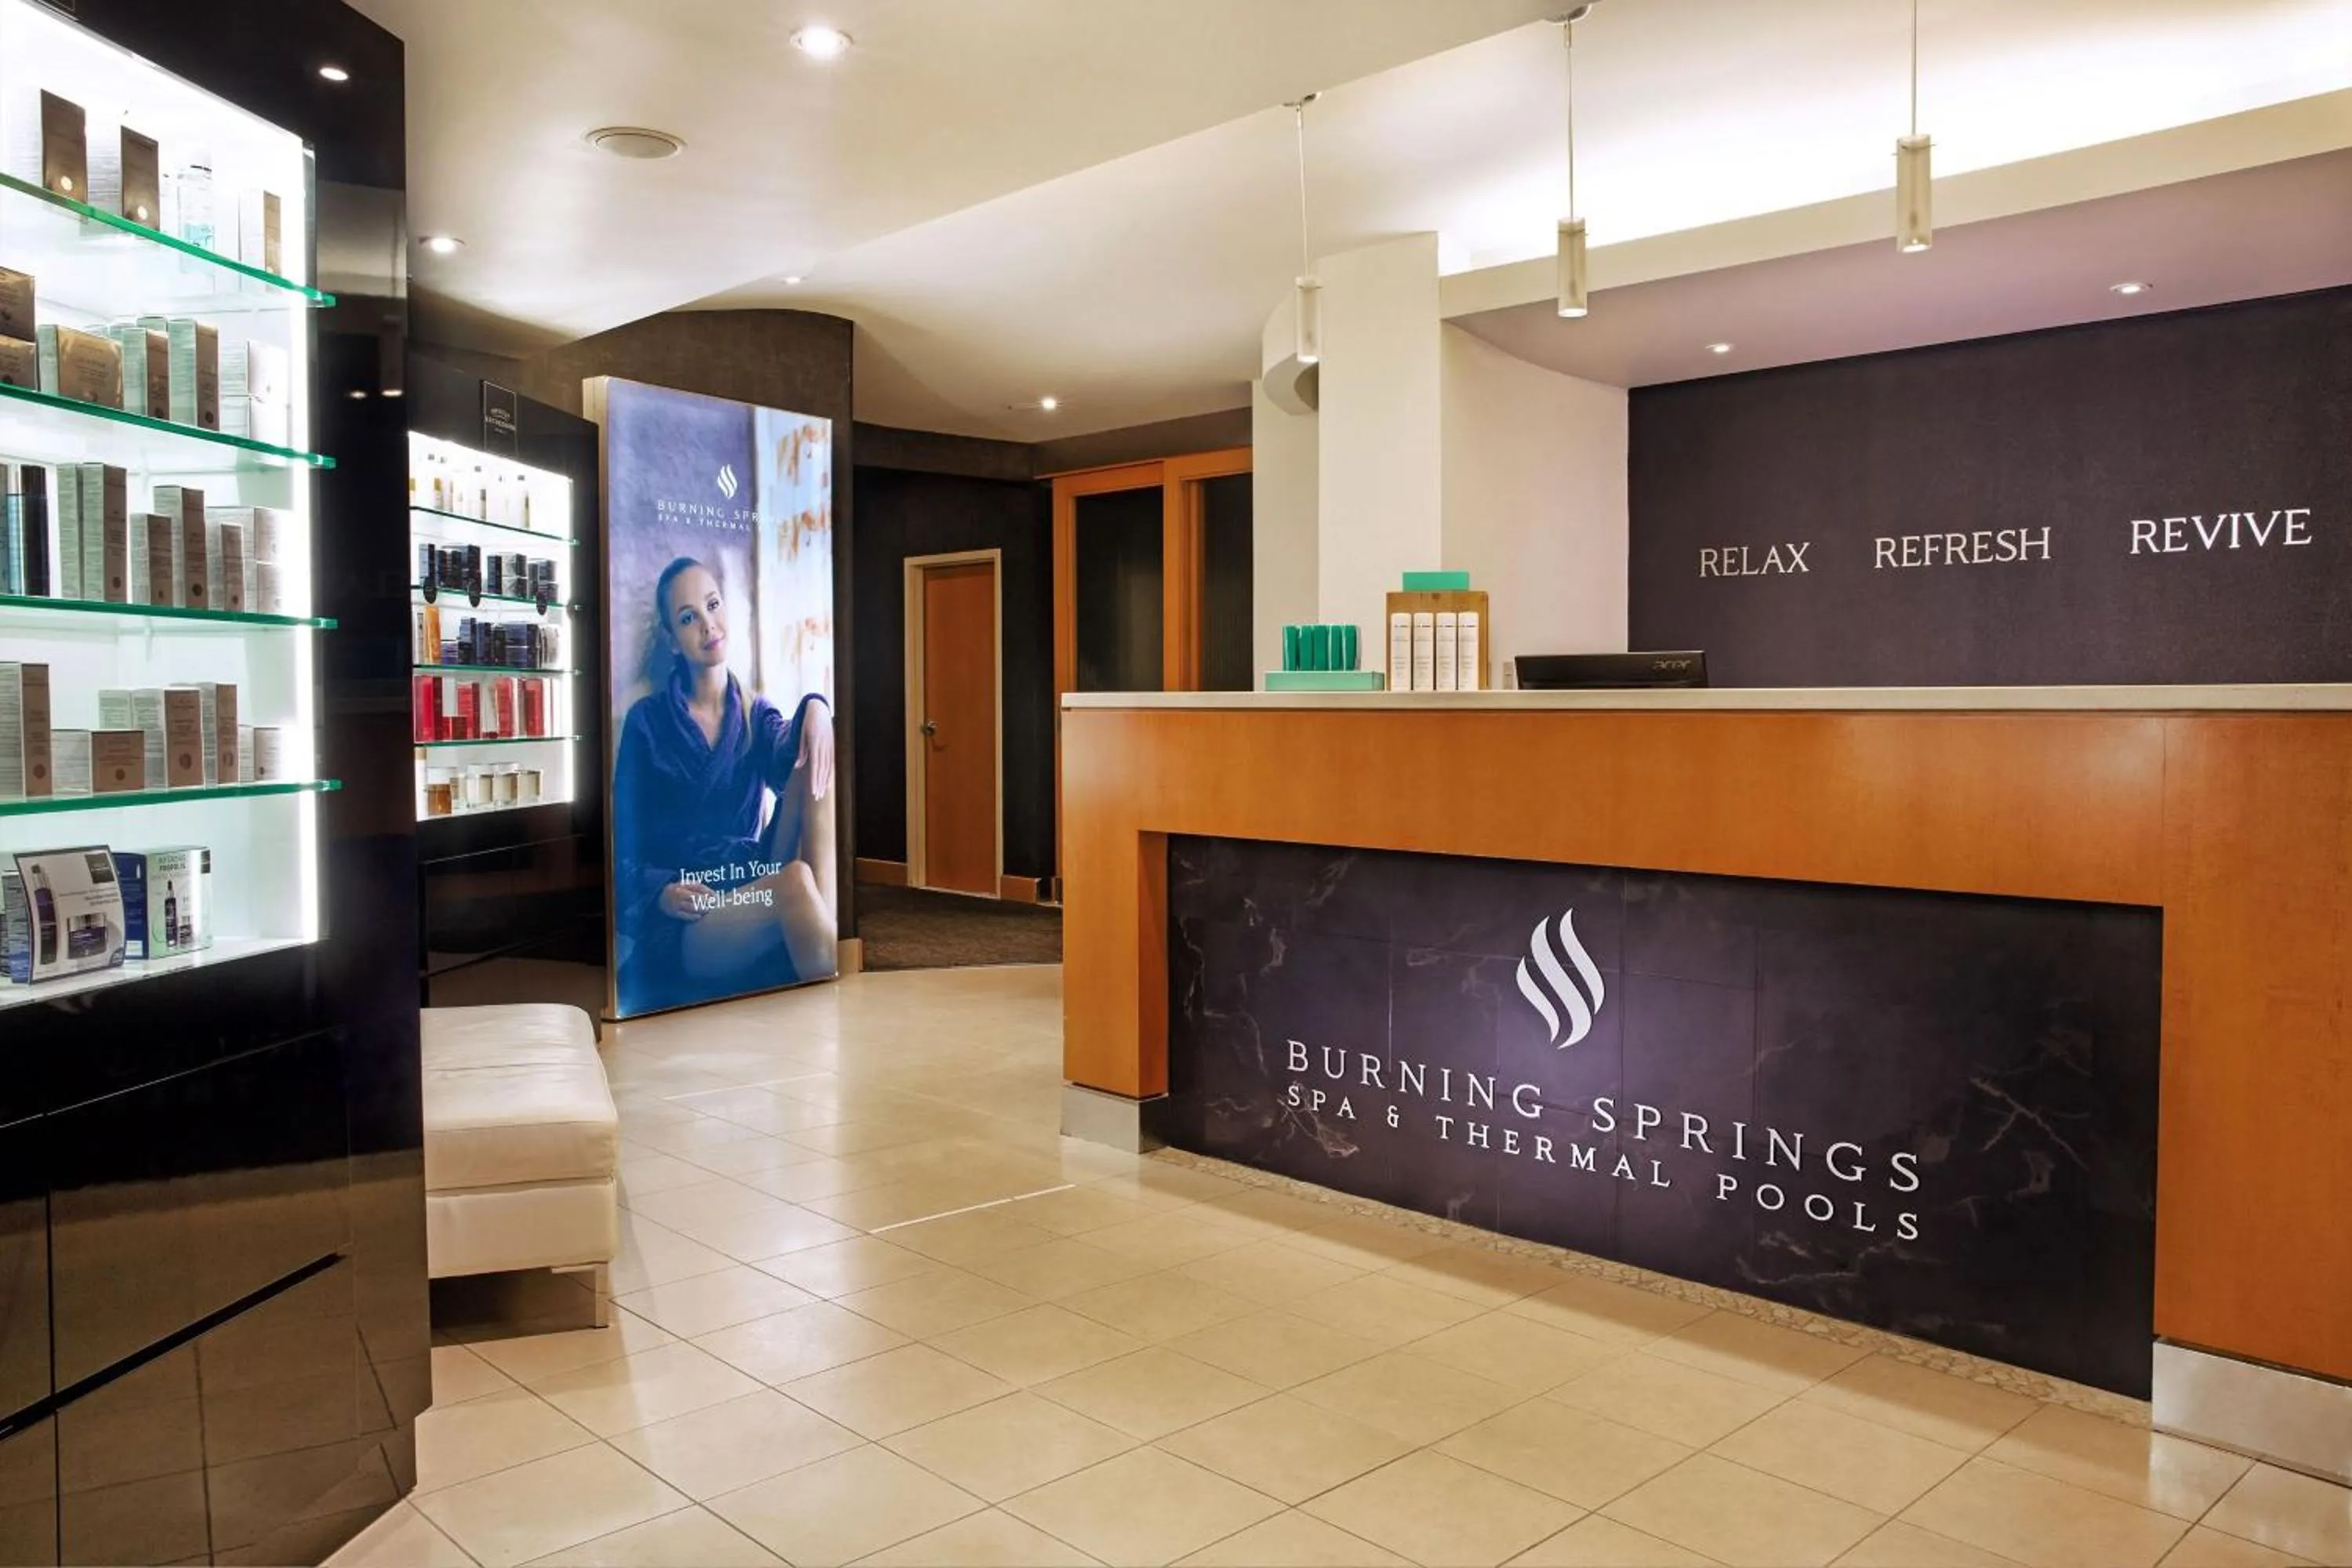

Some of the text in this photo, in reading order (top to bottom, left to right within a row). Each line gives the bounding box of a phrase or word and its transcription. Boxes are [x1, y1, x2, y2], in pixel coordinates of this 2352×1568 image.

[657, 499, 725, 519] BURNING
[699, 518, 750, 532] THERMAL
[1698, 507, 2313, 577] RELAX REFRESH REVIVE
[680, 860, 782, 886] Invest In Your
[689, 886, 773, 912] Well-being
[1287, 1039, 1920, 1192] BURNING SPRINGS
[1288, 1085, 1919, 1240] SPA & THERMAL POOLS
